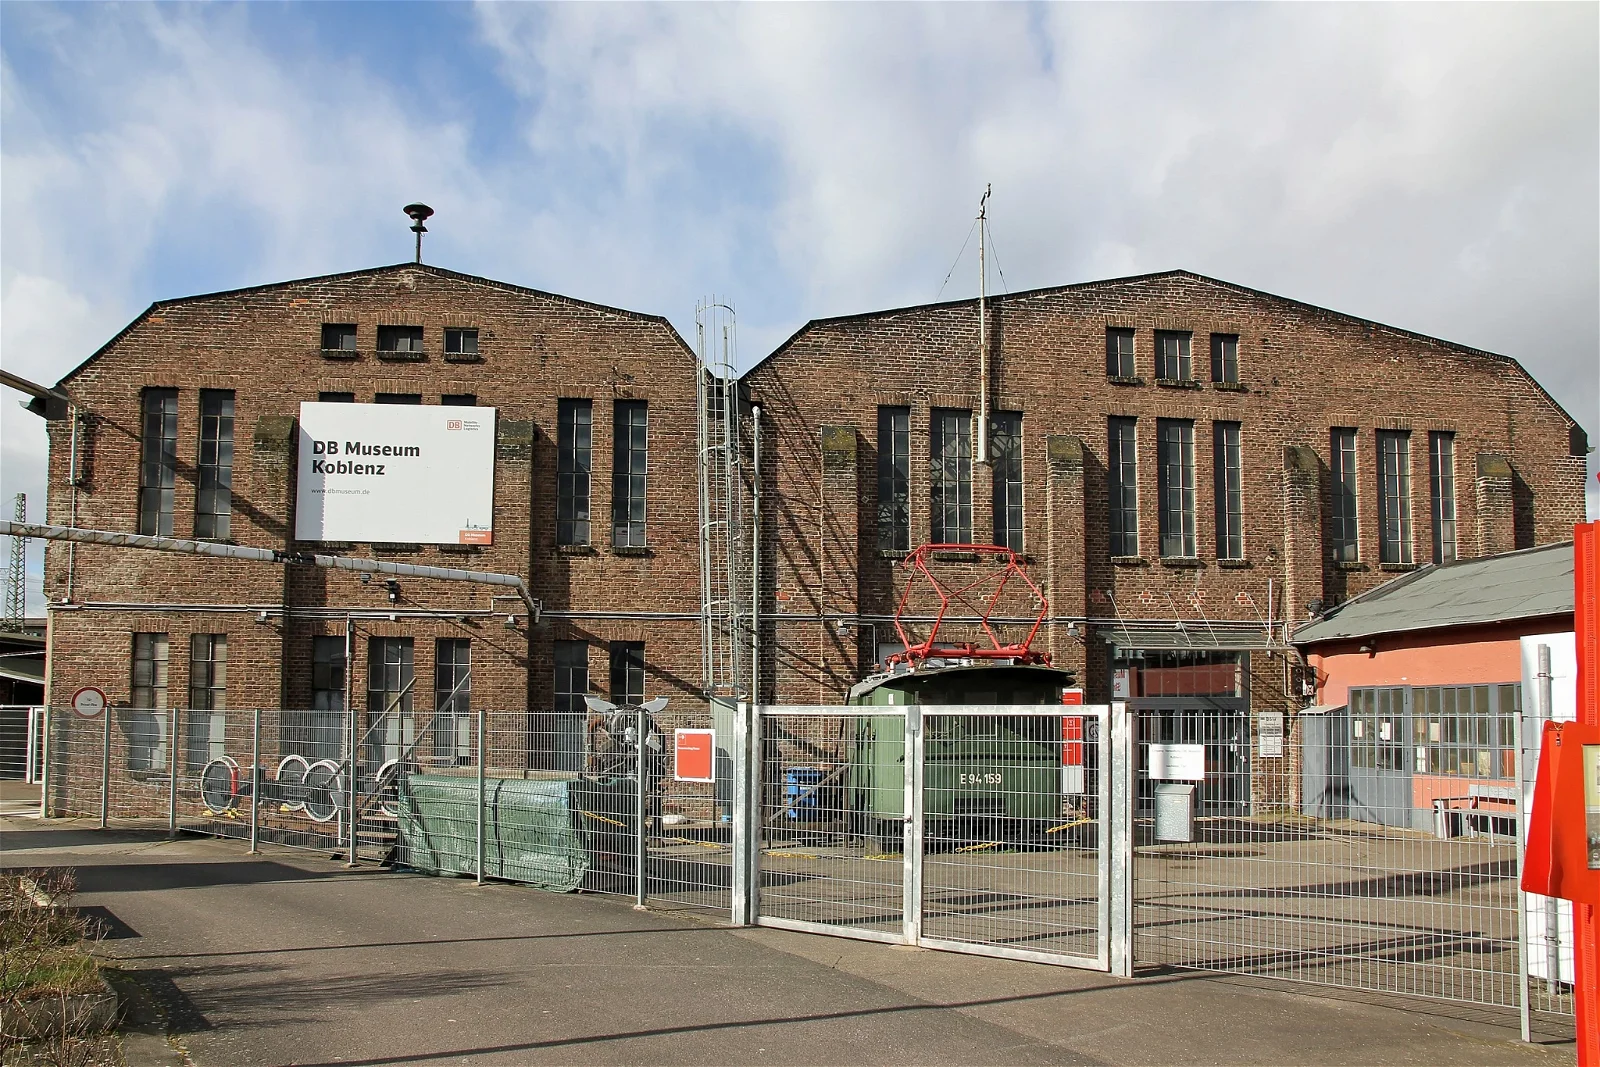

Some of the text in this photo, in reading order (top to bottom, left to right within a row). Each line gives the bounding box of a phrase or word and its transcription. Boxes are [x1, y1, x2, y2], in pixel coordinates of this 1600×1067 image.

[448, 421, 460, 429] DB
[312, 441, 420, 456] DB Museum
[312, 460, 385, 475] Koblenz
[960, 773, 1001, 784] E 94 159
